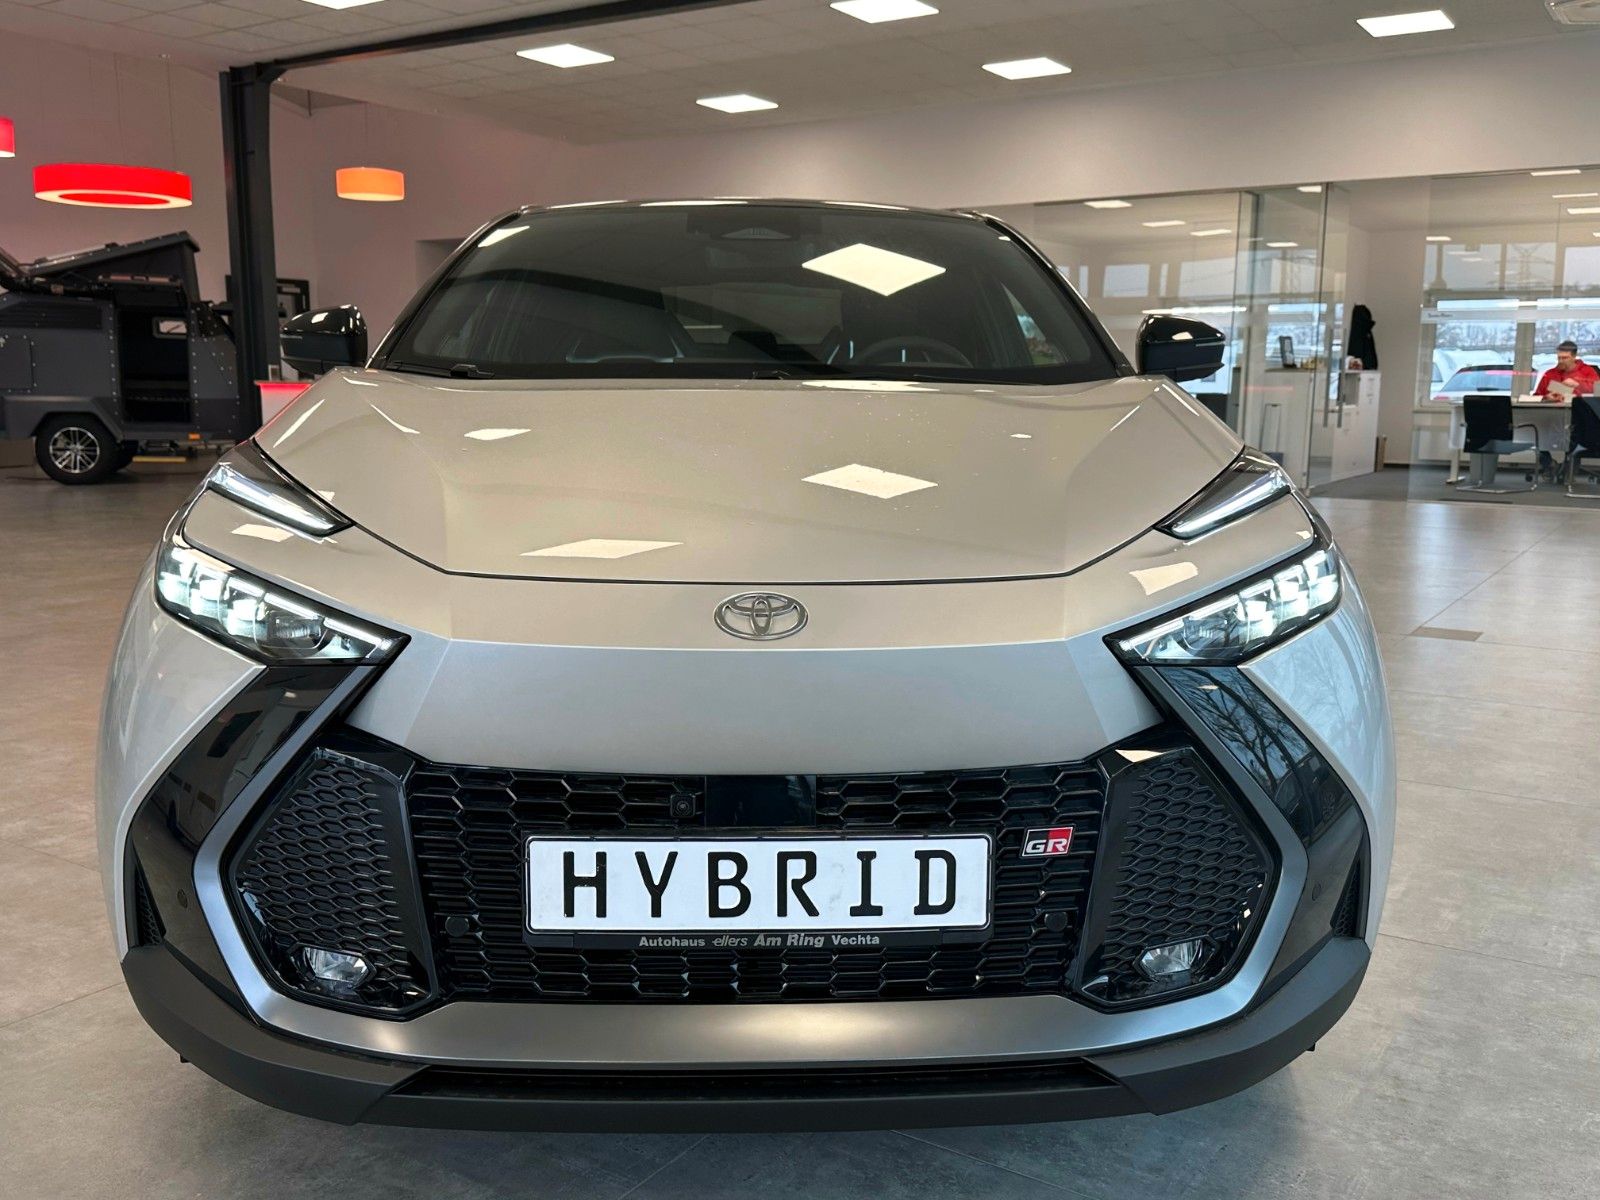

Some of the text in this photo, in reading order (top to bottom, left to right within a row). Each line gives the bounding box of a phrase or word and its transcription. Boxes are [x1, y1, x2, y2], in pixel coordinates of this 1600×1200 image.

[1025, 837, 1068, 854] GR
[562, 848, 958, 919] HYBRID
[639, 933, 881, 949] Autohaus ellers Am Ring Vechta
